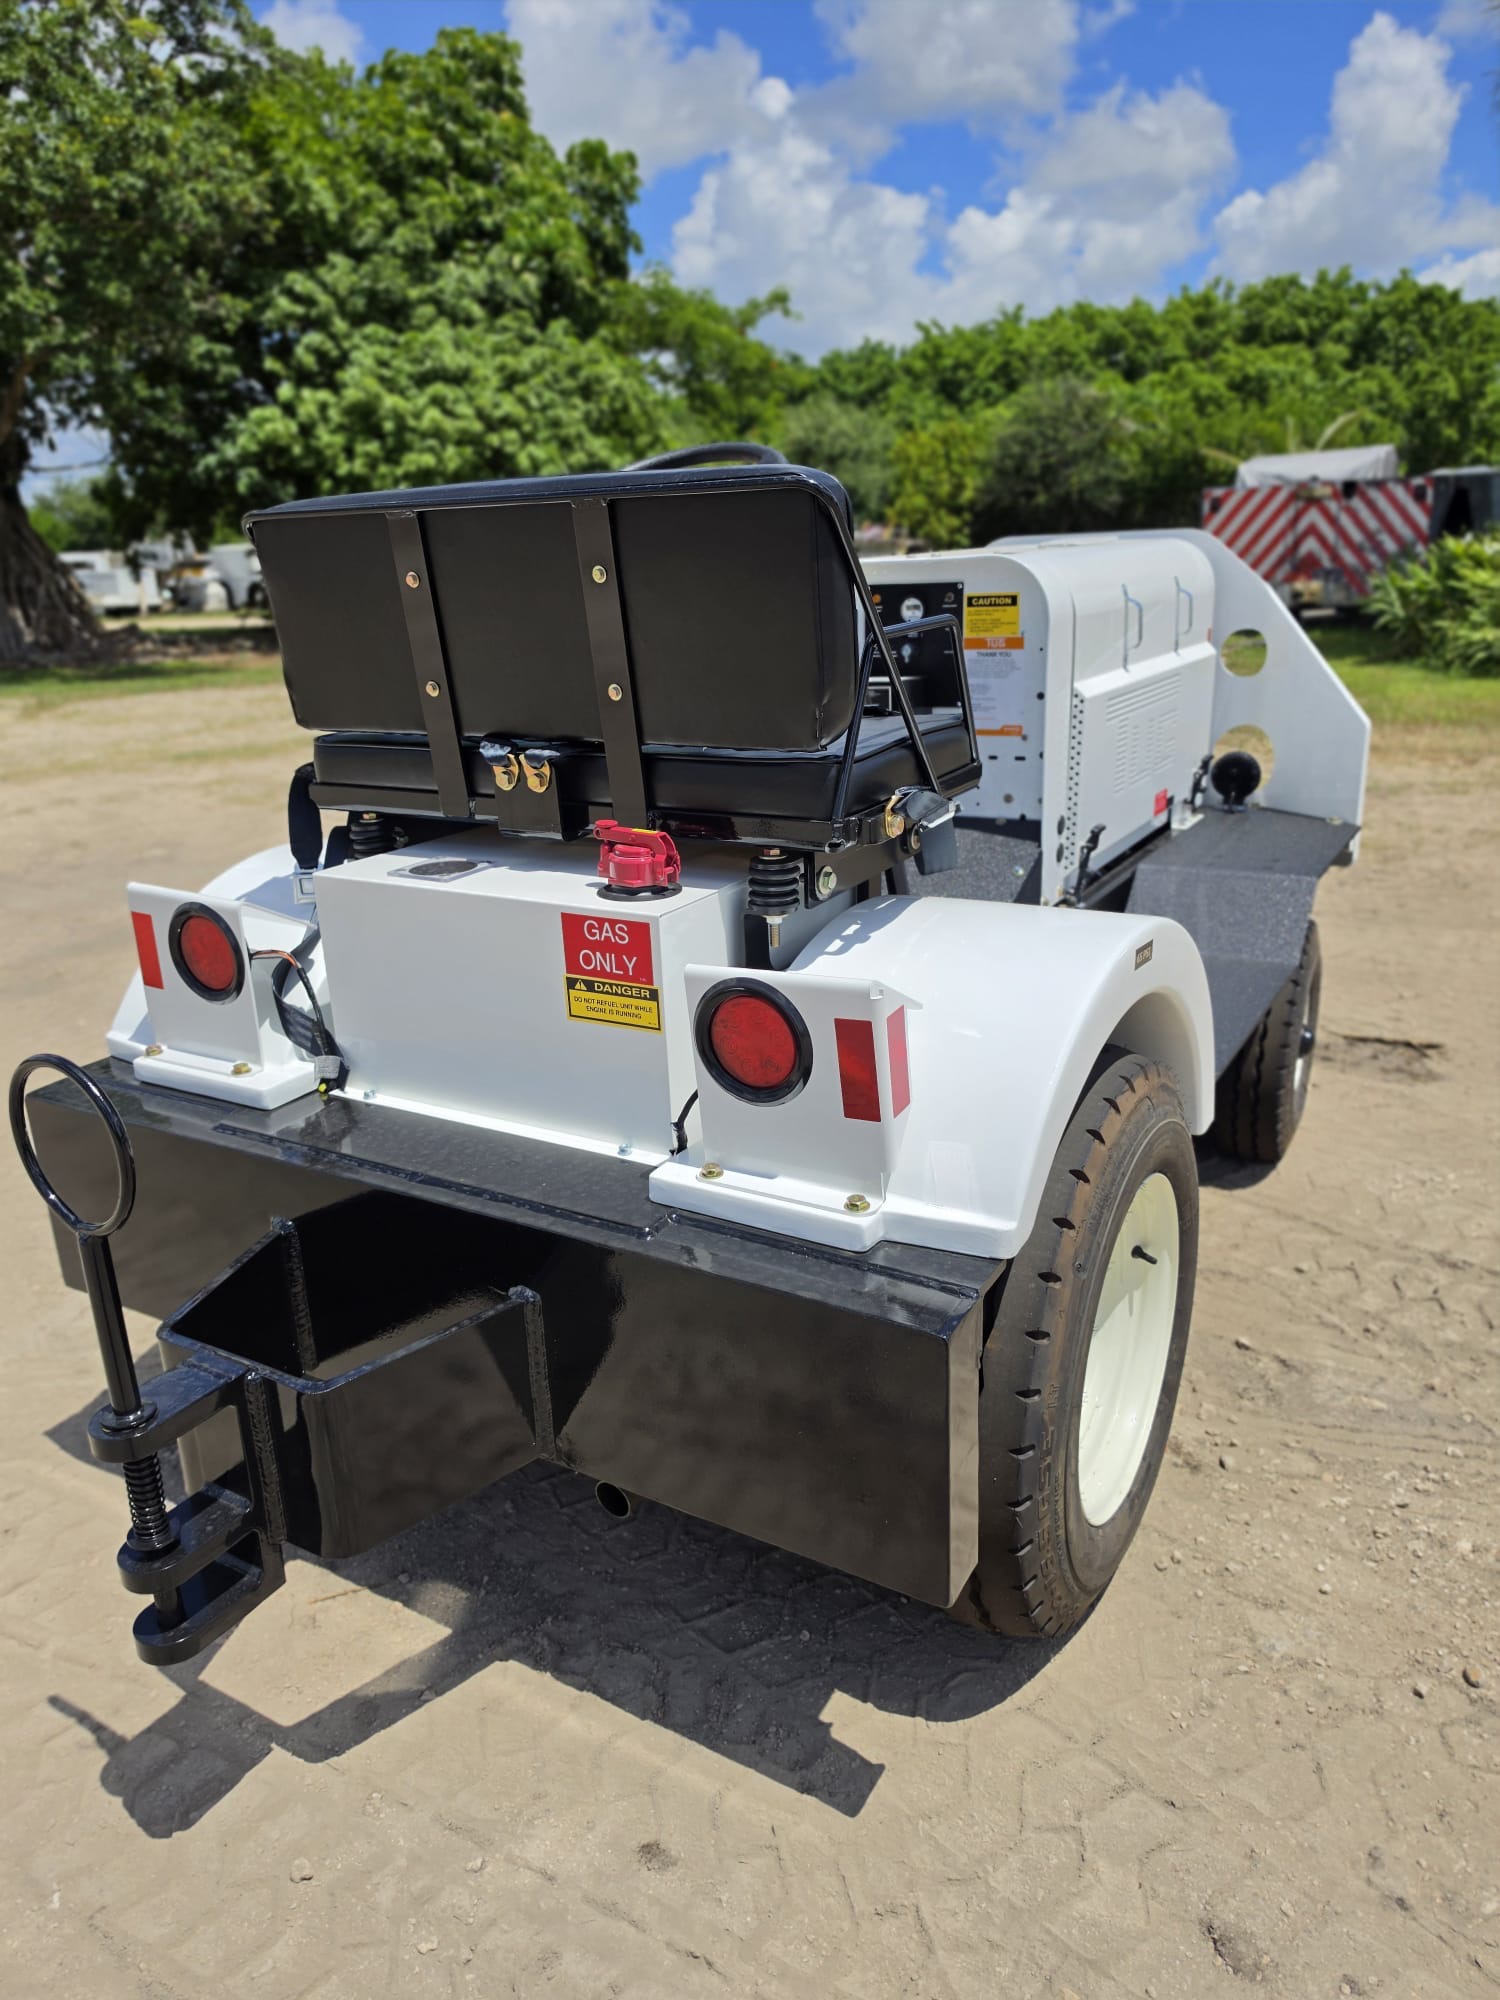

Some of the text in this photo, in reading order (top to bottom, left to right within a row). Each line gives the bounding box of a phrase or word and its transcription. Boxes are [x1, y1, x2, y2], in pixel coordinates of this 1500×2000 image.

[971, 597, 1012, 606] CAUTION
[583, 919, 630, 945] GAS
[579, 949, 638, 976] ONLY
[594, 982, 650, 998] DANGER
[574, 995, 583, 1003] DO
[596, 999, 618, 1008] REFUEL
[620, 1002, 633, 1010] UNIT
[634, 1004, 653, 1013] WHILE
[586, 1005, 606, 1014] ENGINE
[615, 1009, 642, 1020] RUNNING
